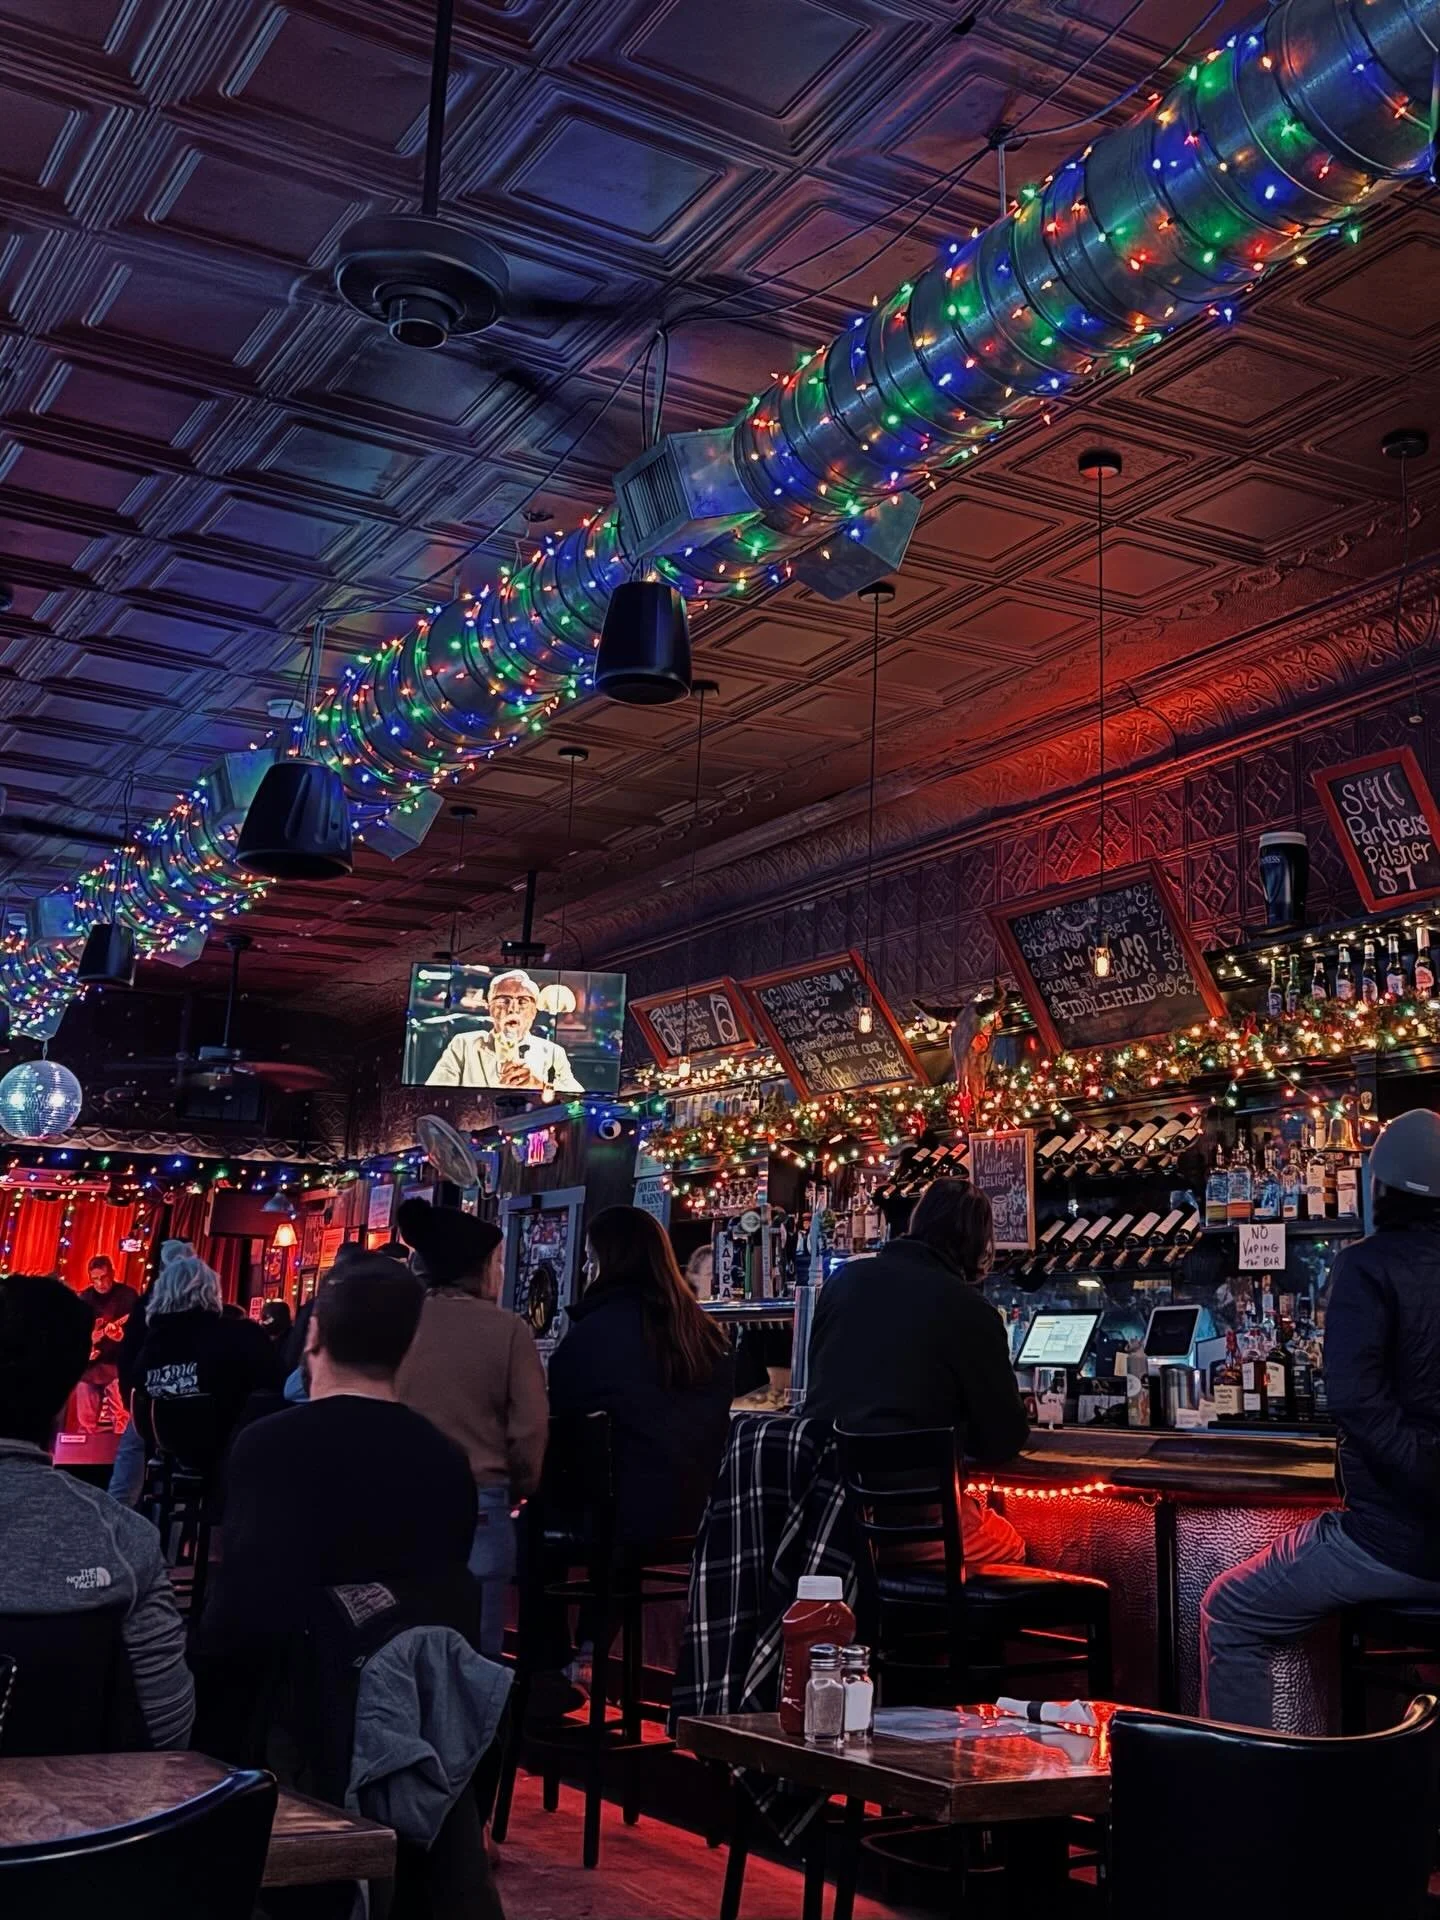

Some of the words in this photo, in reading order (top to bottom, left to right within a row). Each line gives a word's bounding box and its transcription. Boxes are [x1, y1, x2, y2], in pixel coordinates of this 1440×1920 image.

[1341, 771, 1405, 815] Still
[1345, 807, 1432, 847] Partners
[1364, 841, 1432, 875] Pilsner
[1379, 864, 1417, 894] $7
[1055, 983, 1158, 1023] FIDDLEHEAD
[1251, 1226, 1269, 1240] NO
[1242, 1238, 1280, 1257] VAPING
[1263, 1256, 1280, 1267] BAR
[66, 1573, 97, 1584] NORTH
[80, 1568, 96, 1577] THE
[75, 1581, 95, 1590] FACE
